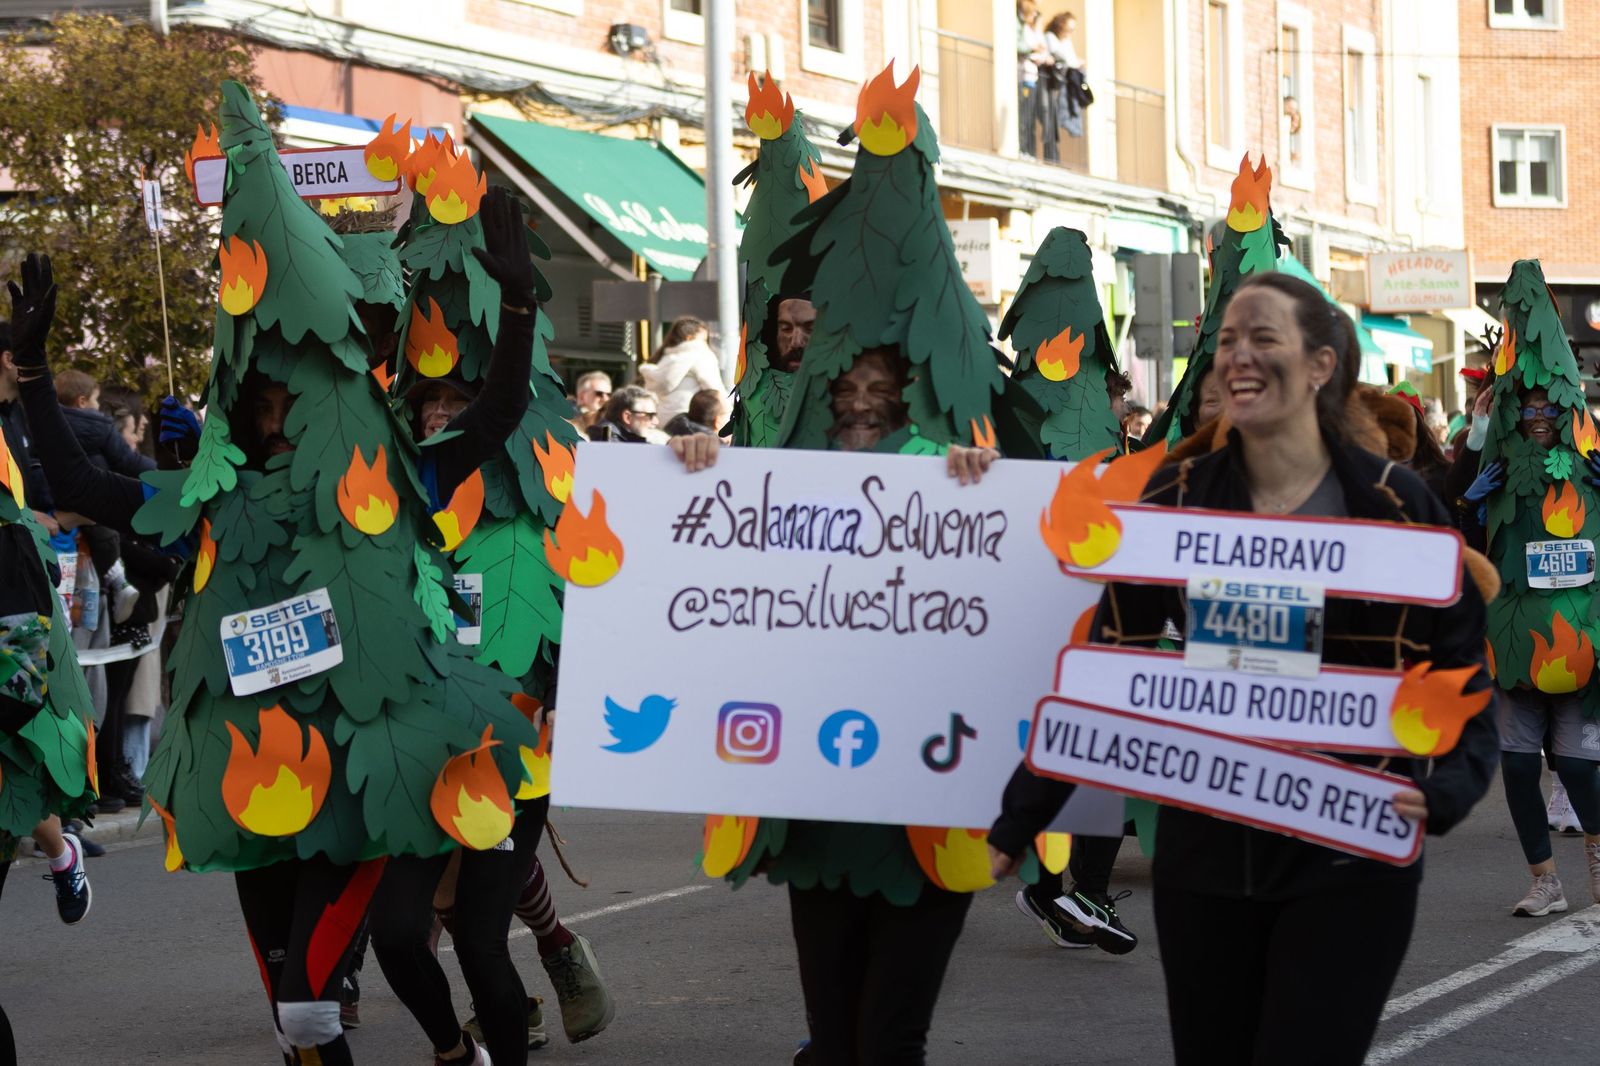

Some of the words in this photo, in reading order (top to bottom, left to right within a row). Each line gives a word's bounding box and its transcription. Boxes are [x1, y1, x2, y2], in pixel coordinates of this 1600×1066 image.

[292, 161, 348, 186] BERCA
[1387, 256, 1454, 277] HELADOS
[1174, 530, 1346, 573] PELABRAVO
[1543, 542, 1588, 552] SETEL
[1538, 552, 1577, 573] 4619
[1224, 582, 1310, 602] SETEL
[250, 599, 321, 628] SETEL
[1203, 601, 1290, 644] 4480
[242, 619, 310, 667] 3199
[1129, 673, 1238, 716] CIUDAD
[1248, 684, 1377, 728] RODRIGO
[1043, 717, 1200, 784] VILLASECO
[1207, 756, 1249, 796] DE
[1254, 767, 1312, 812] LOS
[1318, 784, 1411, 840] REYES
